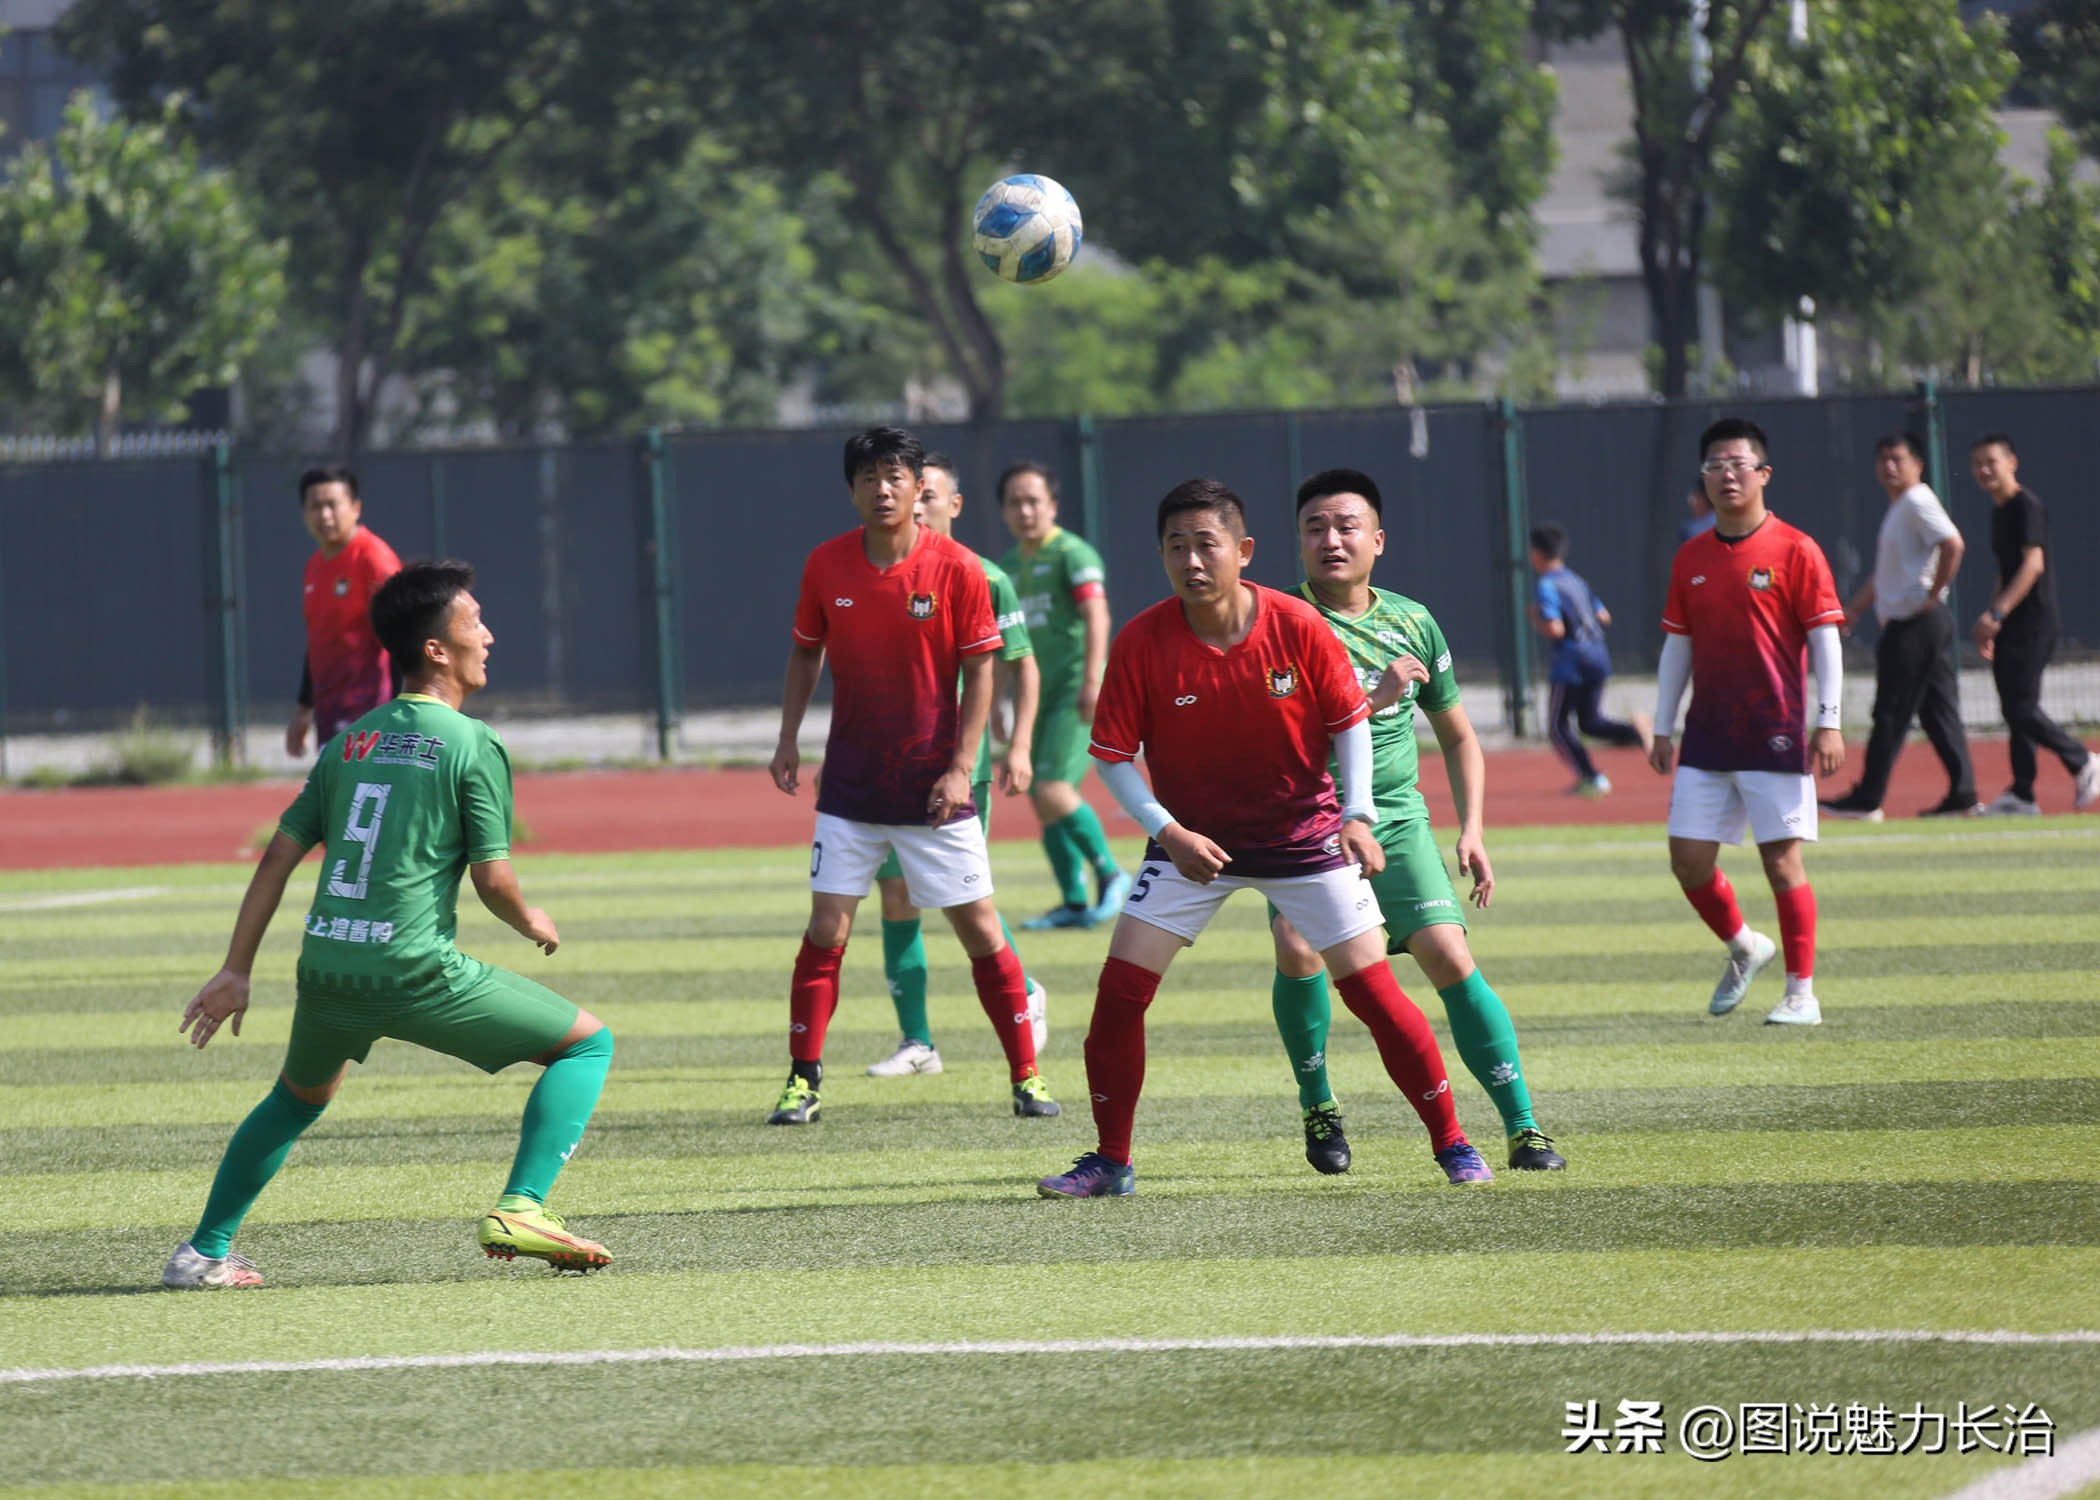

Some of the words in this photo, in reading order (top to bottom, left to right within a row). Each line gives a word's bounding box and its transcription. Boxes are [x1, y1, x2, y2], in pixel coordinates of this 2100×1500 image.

[378, 732, 446, 761] 华莱士
[325, 782, 392, 899] 9
[1129, 866, 1161, 902] 5
